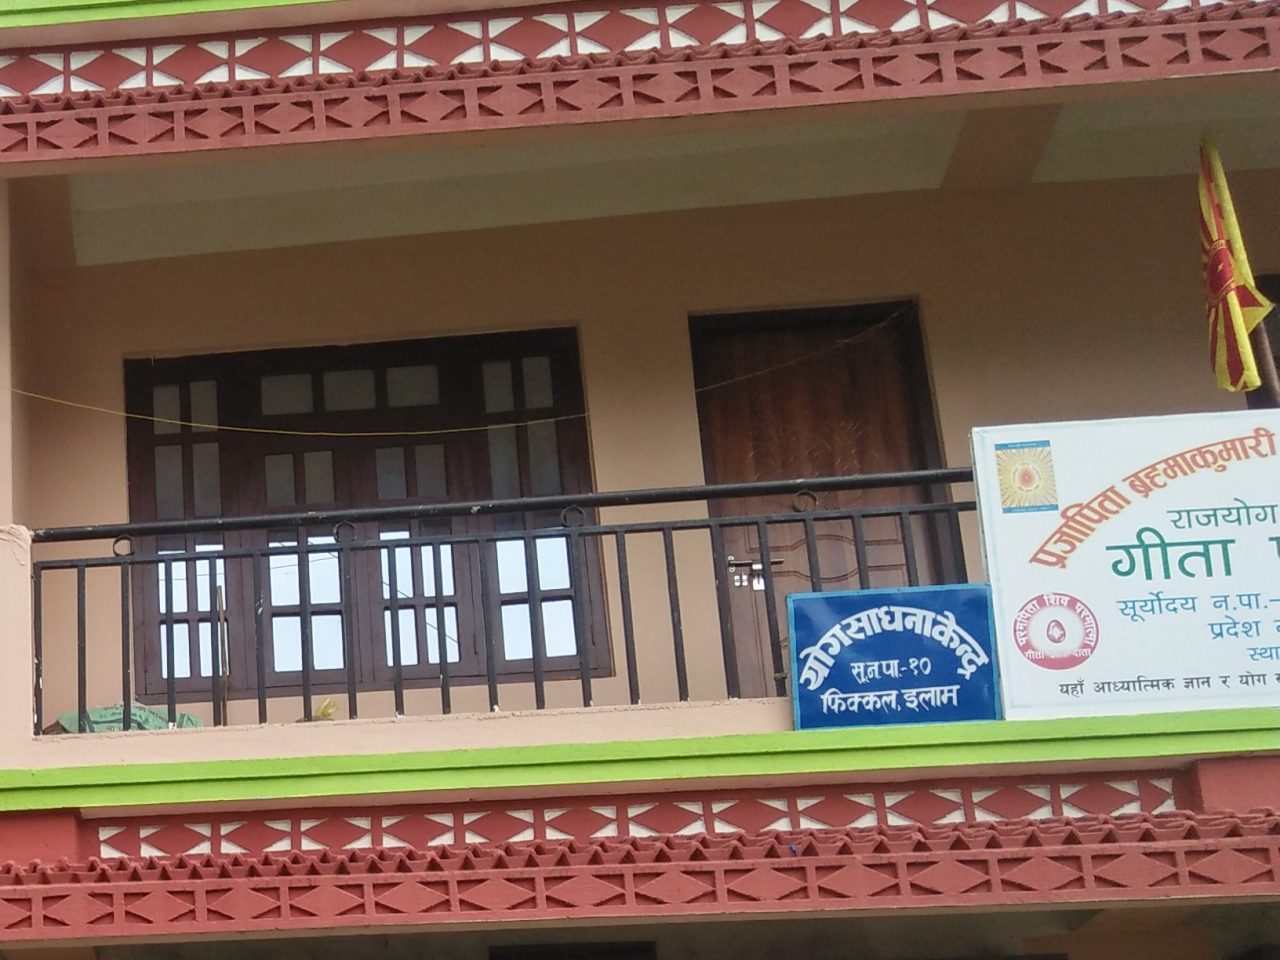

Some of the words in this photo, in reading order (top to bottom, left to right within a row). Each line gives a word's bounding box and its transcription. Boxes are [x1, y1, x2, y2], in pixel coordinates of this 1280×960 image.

[1028, 484, 1132, 569] प्रजापिता
[1167, 497, 1278, 530] राजयोग
[1105, 526, 1236, 581] गीता
[1117, 591, 1198, 623] सूर्योदय
[1208, 615, 1261, 640] प्रदेश
[902, 685, 961, 712] इलाम
[1058, 677, 1085, 699] यहाँ
[1093, 674, 1176, 695] आध्यात्मिक
[1183, 675, 1211, 690] ज्ञान
[1219, 675, 1231, 690] र
[1238, 670, 1268, 687] योग
